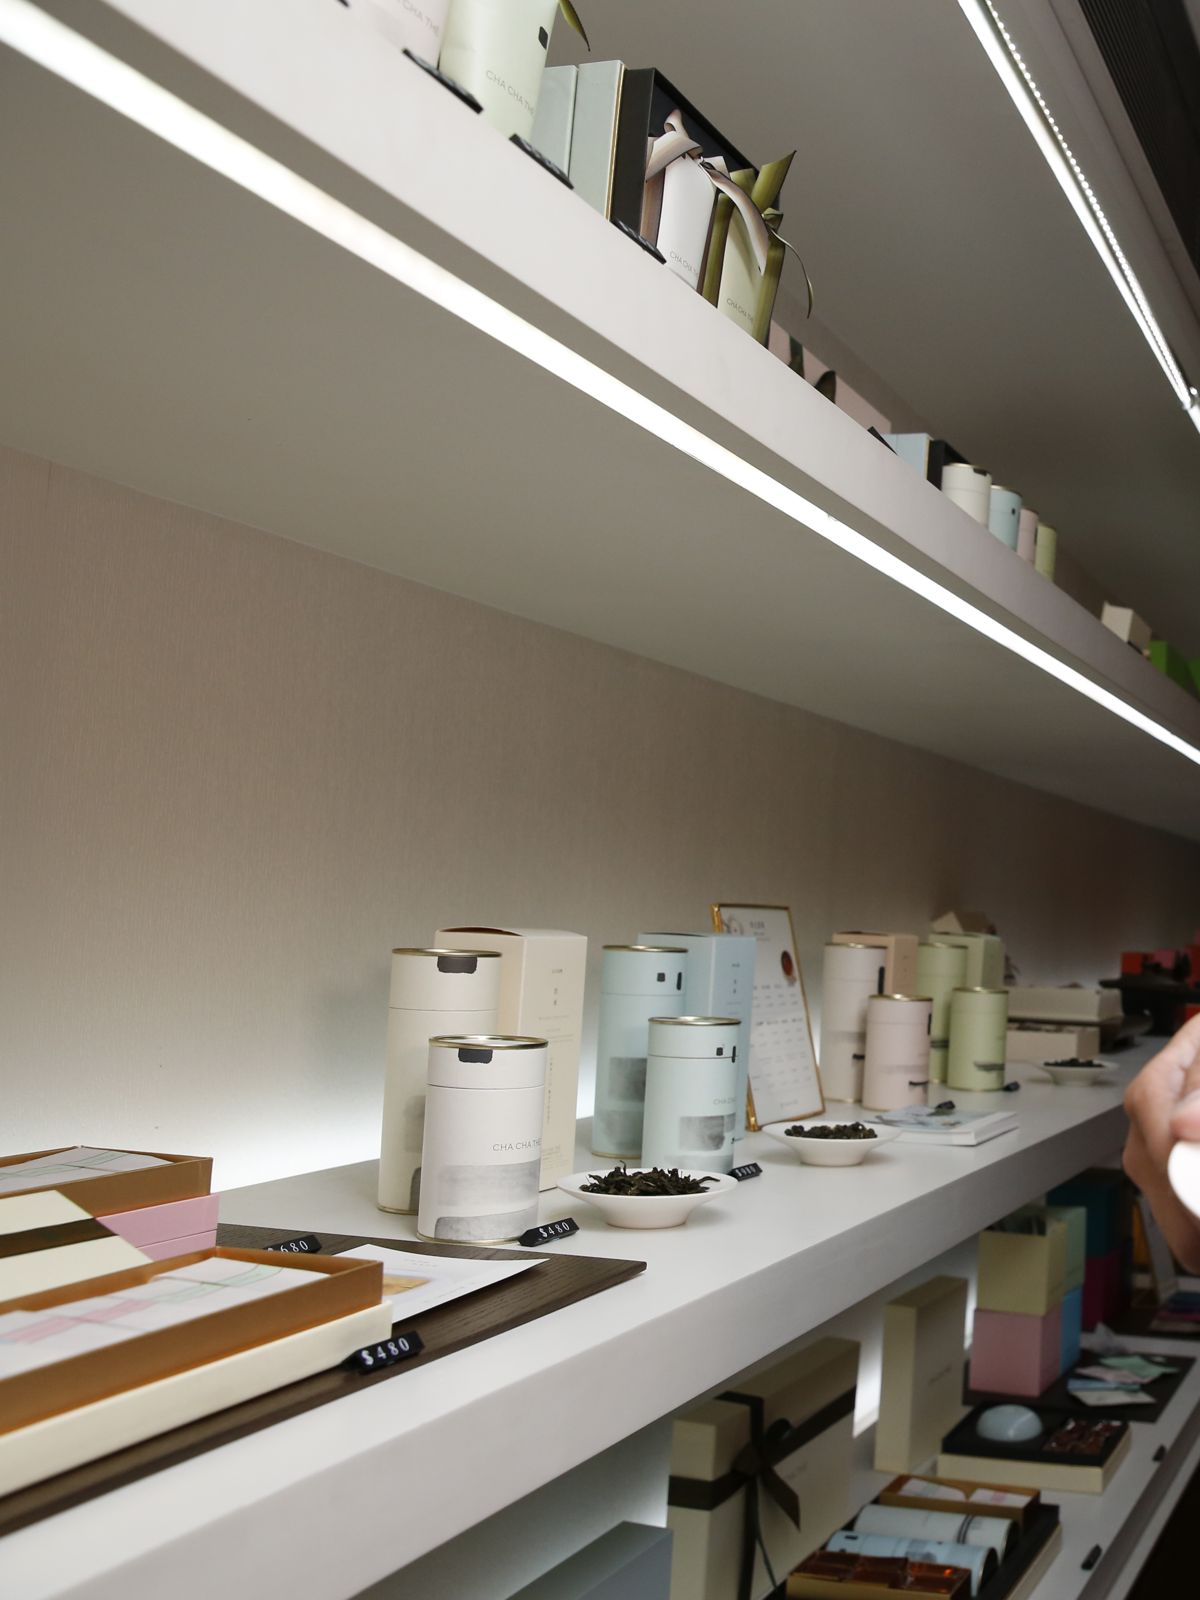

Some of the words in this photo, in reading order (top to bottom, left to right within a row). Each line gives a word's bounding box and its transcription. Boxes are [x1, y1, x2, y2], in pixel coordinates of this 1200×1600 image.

[485, 69, 506, 91] CHA
[507, 85, 523, 105] CHA
[492, 1143, 514, 1152] CHA
[515, 1140, 532, 1150] CHA
[539, 1221, 570, 1238] $480
[360, 1337, 410, 1366] $480
